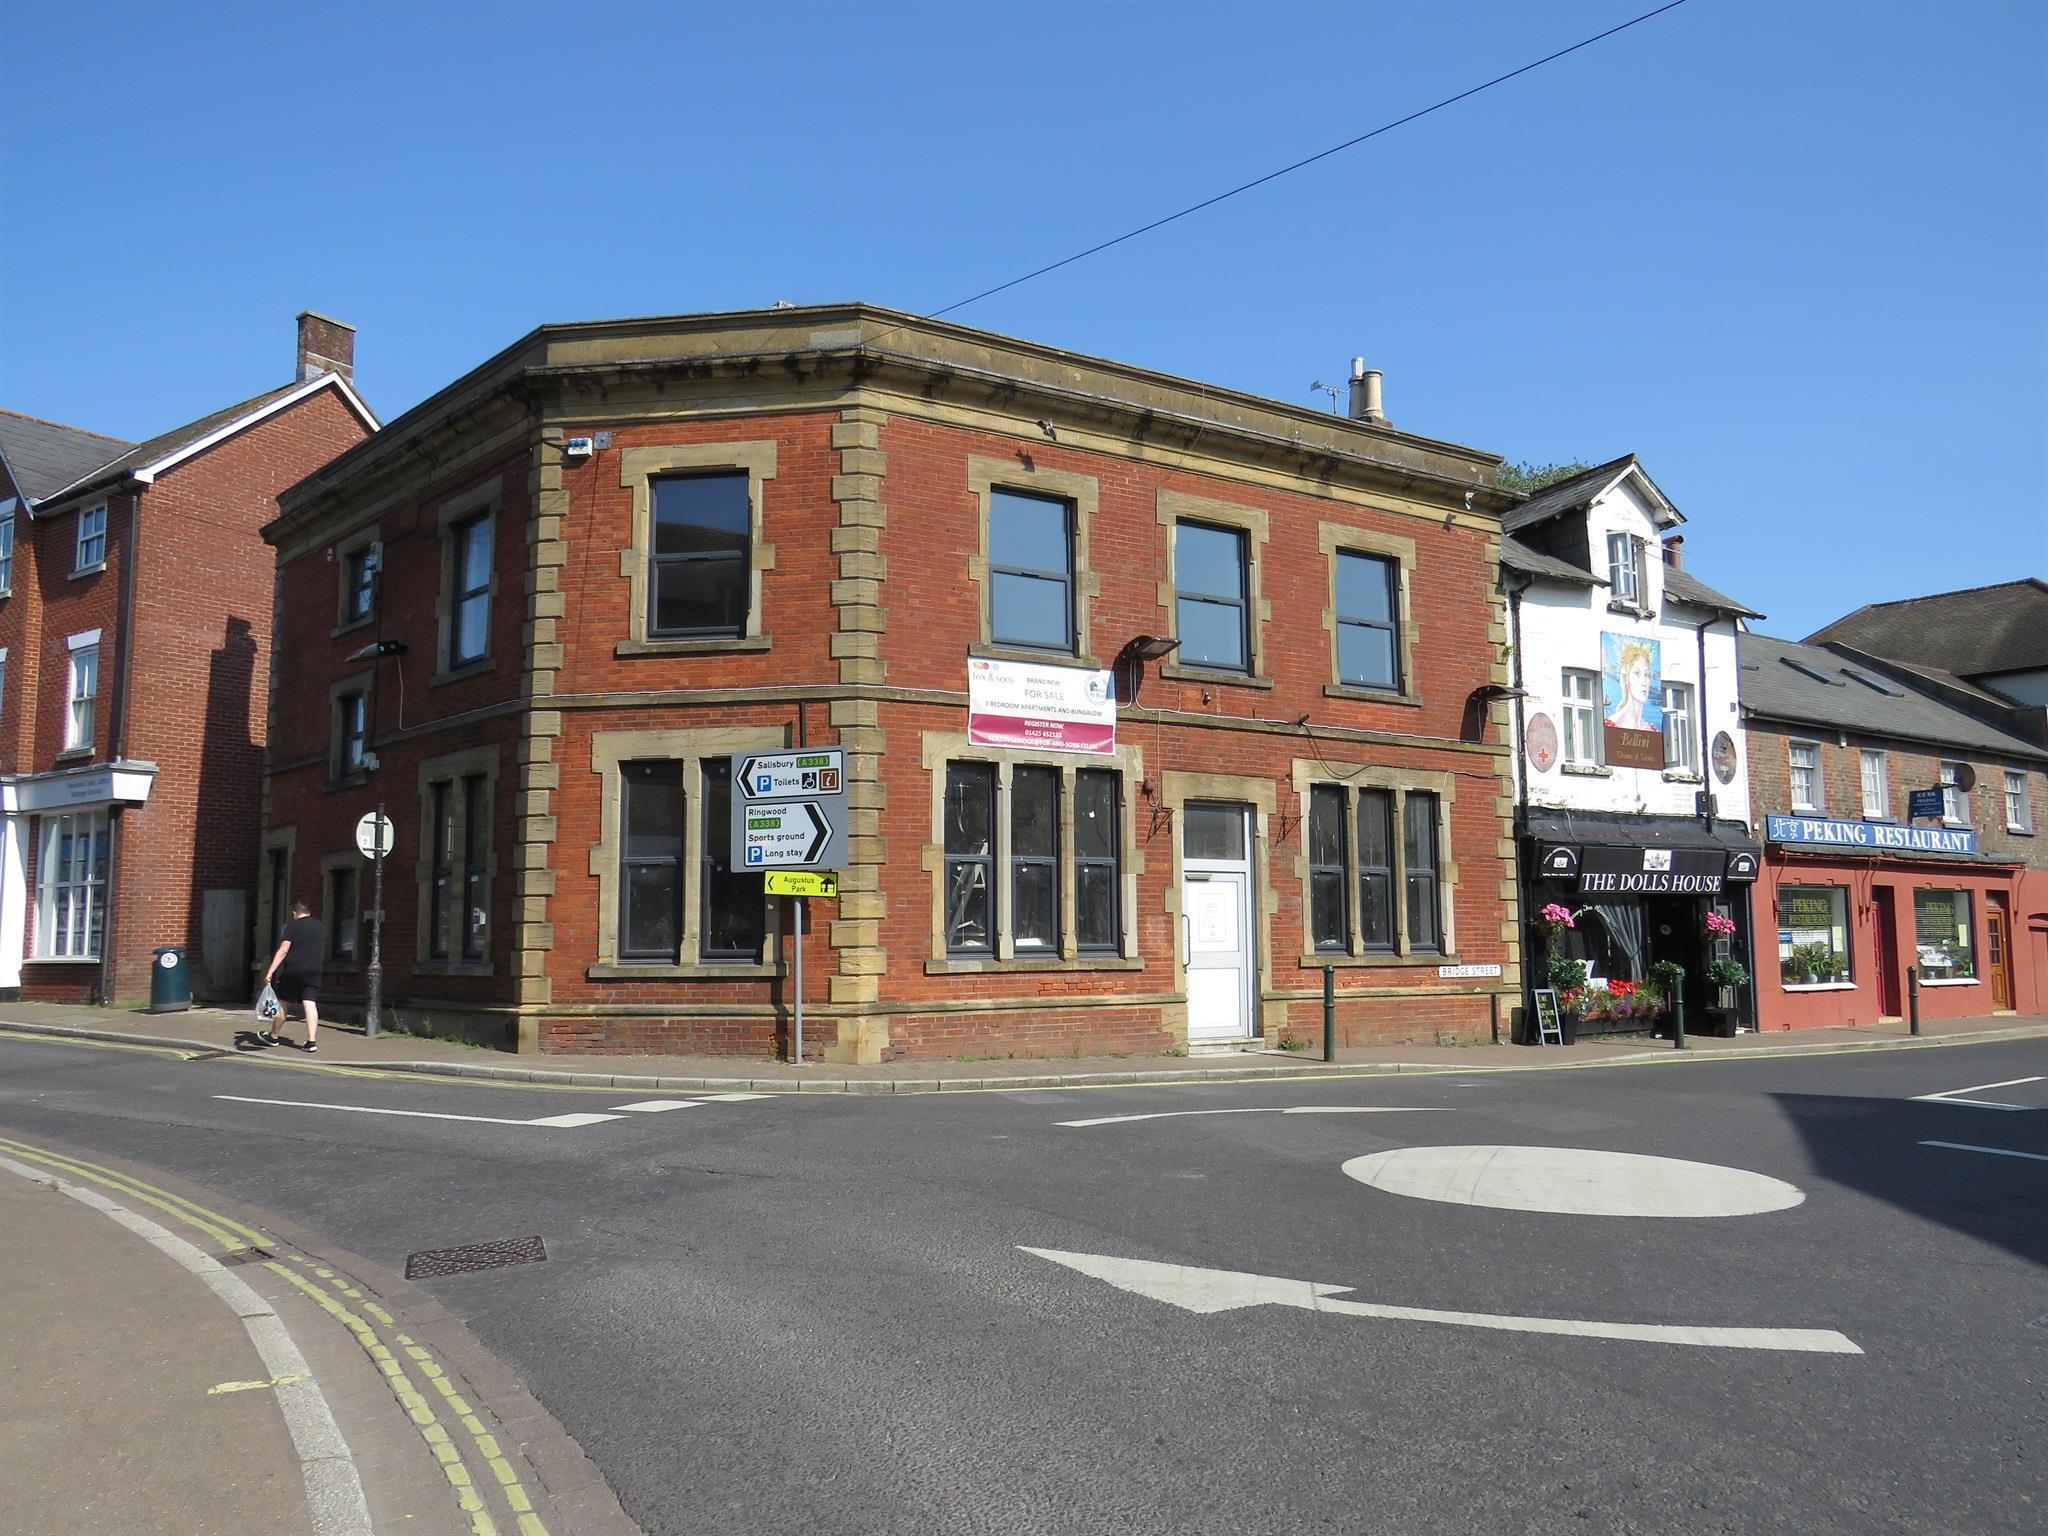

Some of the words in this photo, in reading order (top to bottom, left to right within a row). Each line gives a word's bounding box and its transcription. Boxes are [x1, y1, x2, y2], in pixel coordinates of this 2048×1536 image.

[973, 671, 986, 681] fox
[988, 673, 995, 682] &
[996, 675, 1015, 685] sons
[1026, 677, 1046, 685] BRAND
[1047, 678, 1060, 686] NEW
[1025, 689, 1042, 698] FOR
[1044, 691, 1064, 701] SALE
[990, 701, 1020, 709] BEDROOM
[1021, 703, 1057, 712] APARTMENTS
[1058, 706, 1070, 714] AND
[1071, 707, 1102, 717] BUNGALOW
[1024, 720, 1049, 728] REGISTER
[1620, 731, 1650, 748] Bellini
[757, 760, 794, 769] Salisbury
[797, 756, 828, 767] (A338)
[760, 777, 769, 790] P
[774, 778, 800, 787] Toilets
[748, 808, 787, 817] Ringwood
[749, 818, 780, 829] (A338)
[1773, 818, 1799, 840] 北京
[748, 834, 775, 843] Sports
[777, 832, 805, 841] ground
[1802, 821, 1866, 844] PEKING
[1873, 826, 1970, 851] RESTAURANT
[751, 848, 760, 861] P
[765, 850, 784, 858] Long
[786, 849, 803, 858] stay
[783, 876, 815, 884] Augustus
[1582, 873, 1616, 891] THE
[1620, 873, 1668, 892] DOLLS
[1671, 875, 1721, 892] HOUSE
[1442, 967, 1469, 976] BRIDGE
[1471, 966, 1498, 975] STREET
